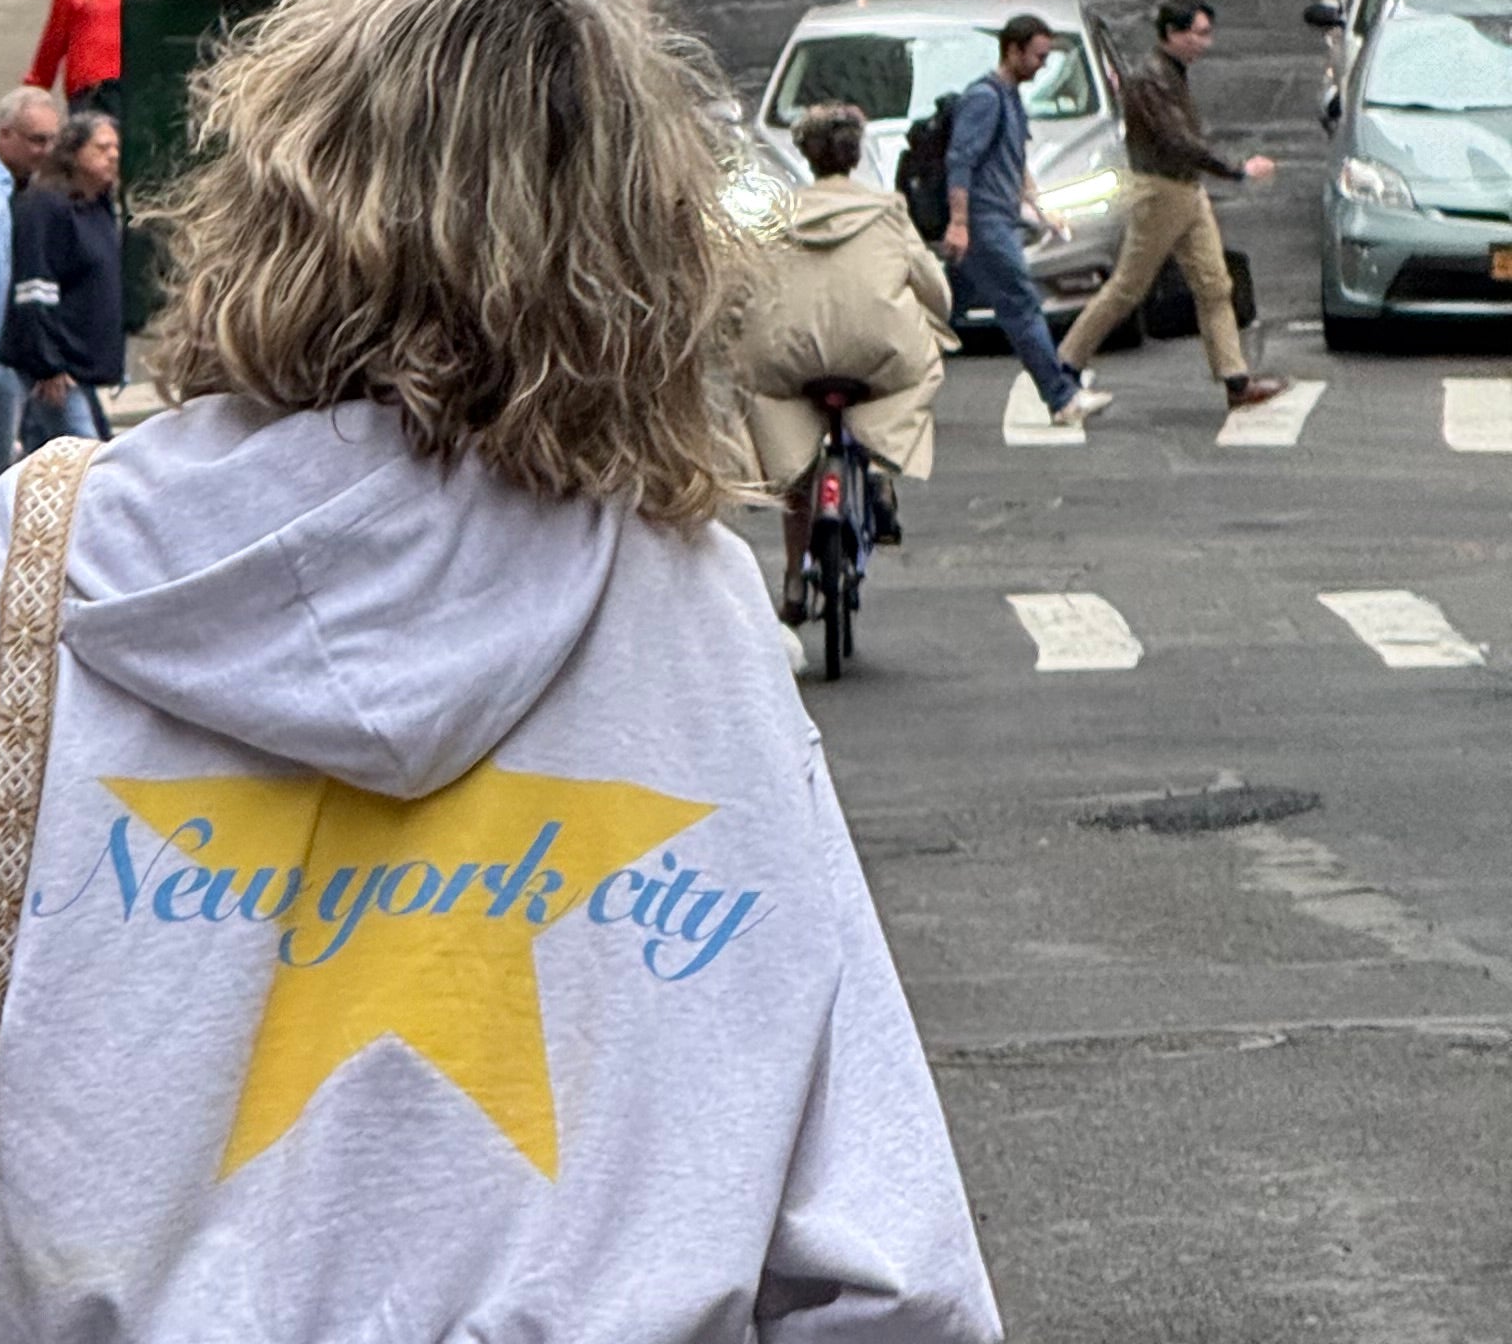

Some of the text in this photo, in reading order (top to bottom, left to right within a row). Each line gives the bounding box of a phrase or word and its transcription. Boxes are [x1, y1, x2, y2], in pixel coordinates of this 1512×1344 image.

[31, 816, 777, 981] New york city
